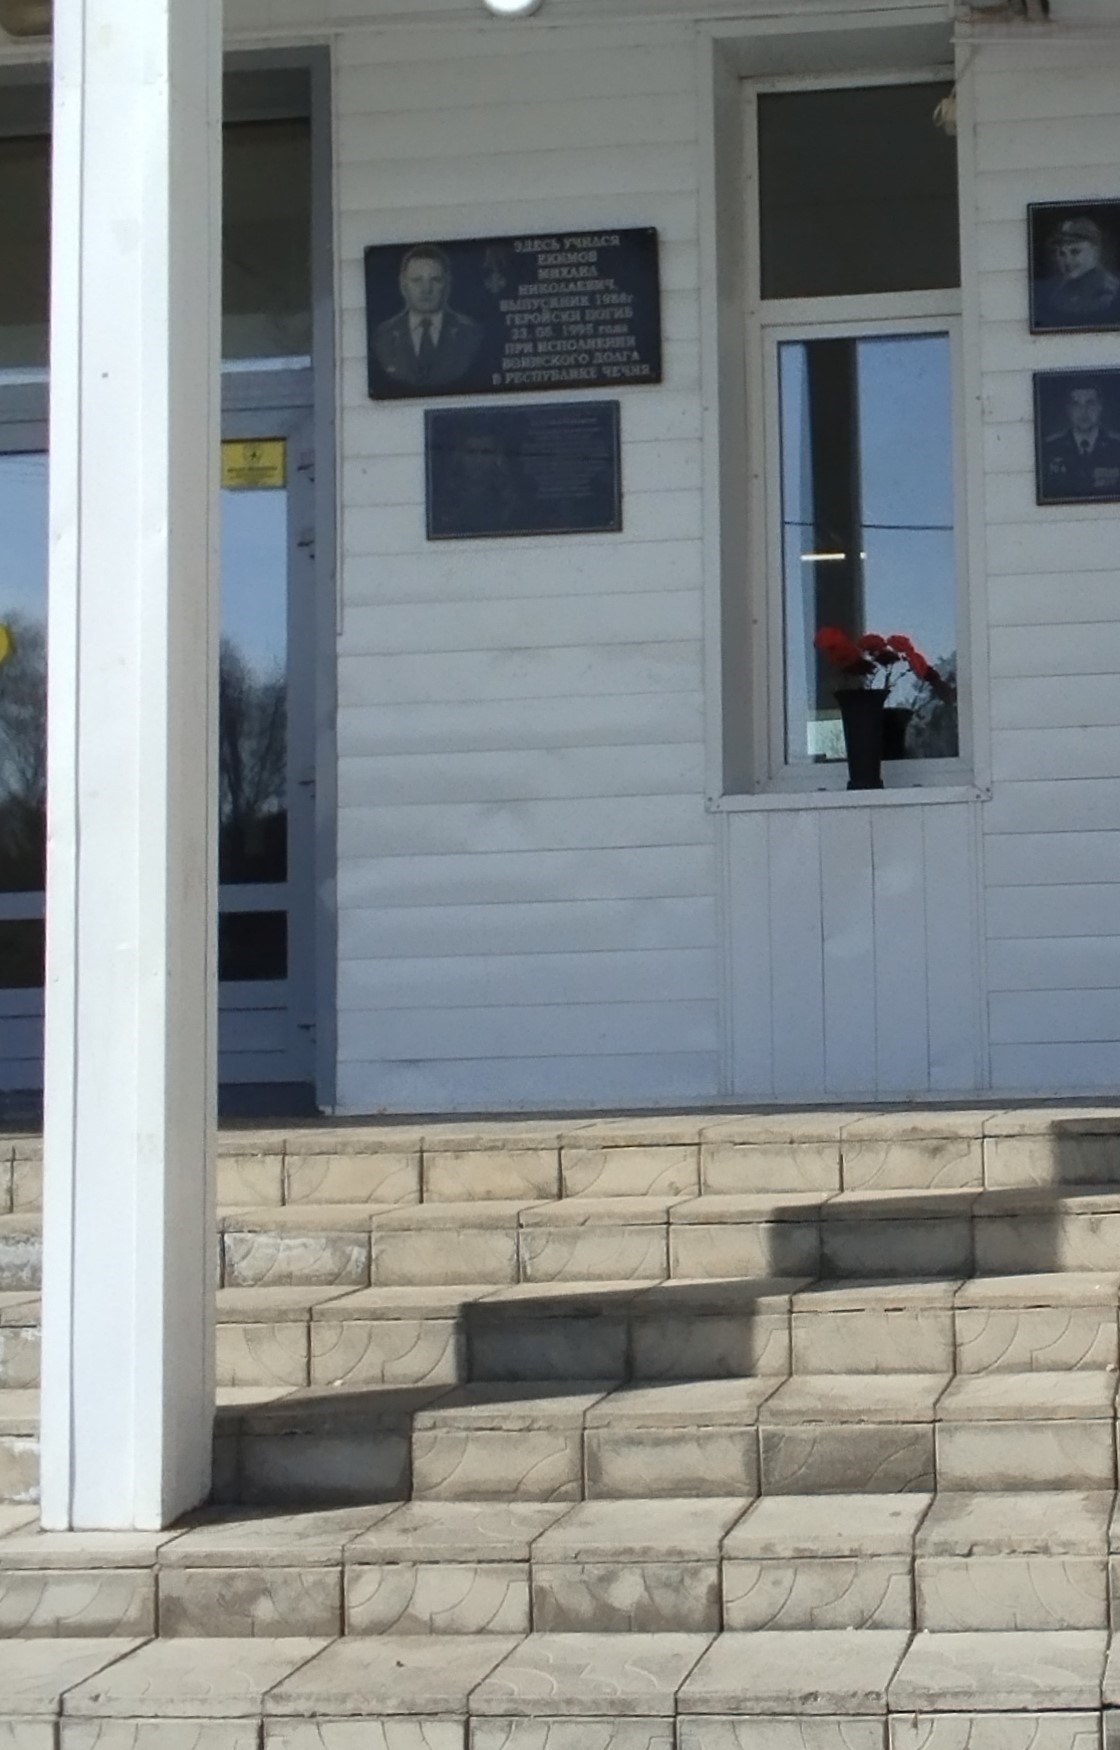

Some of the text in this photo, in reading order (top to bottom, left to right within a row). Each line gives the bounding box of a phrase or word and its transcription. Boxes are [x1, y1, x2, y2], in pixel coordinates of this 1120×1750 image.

[513, 235, 620, 252] ЗДЕСЬ УЧИЛСЯ
[537, 265, 598, 280] МИХАИЛ
[501, 295, 591, 312] ВЫПУСКНИК
[506, 306, 633, 325] ГЕРОЙСКИ ПОГИБ
[504, 335, 636, 355] ПРИ ИСПОЛНЕНИИ
[502, 350, 641, 370] ВОИНСКОГО ДОЛГА
[492, 363, 650, 385] В РЕСПУБЛИКЕ ЧЕЧНЯ
